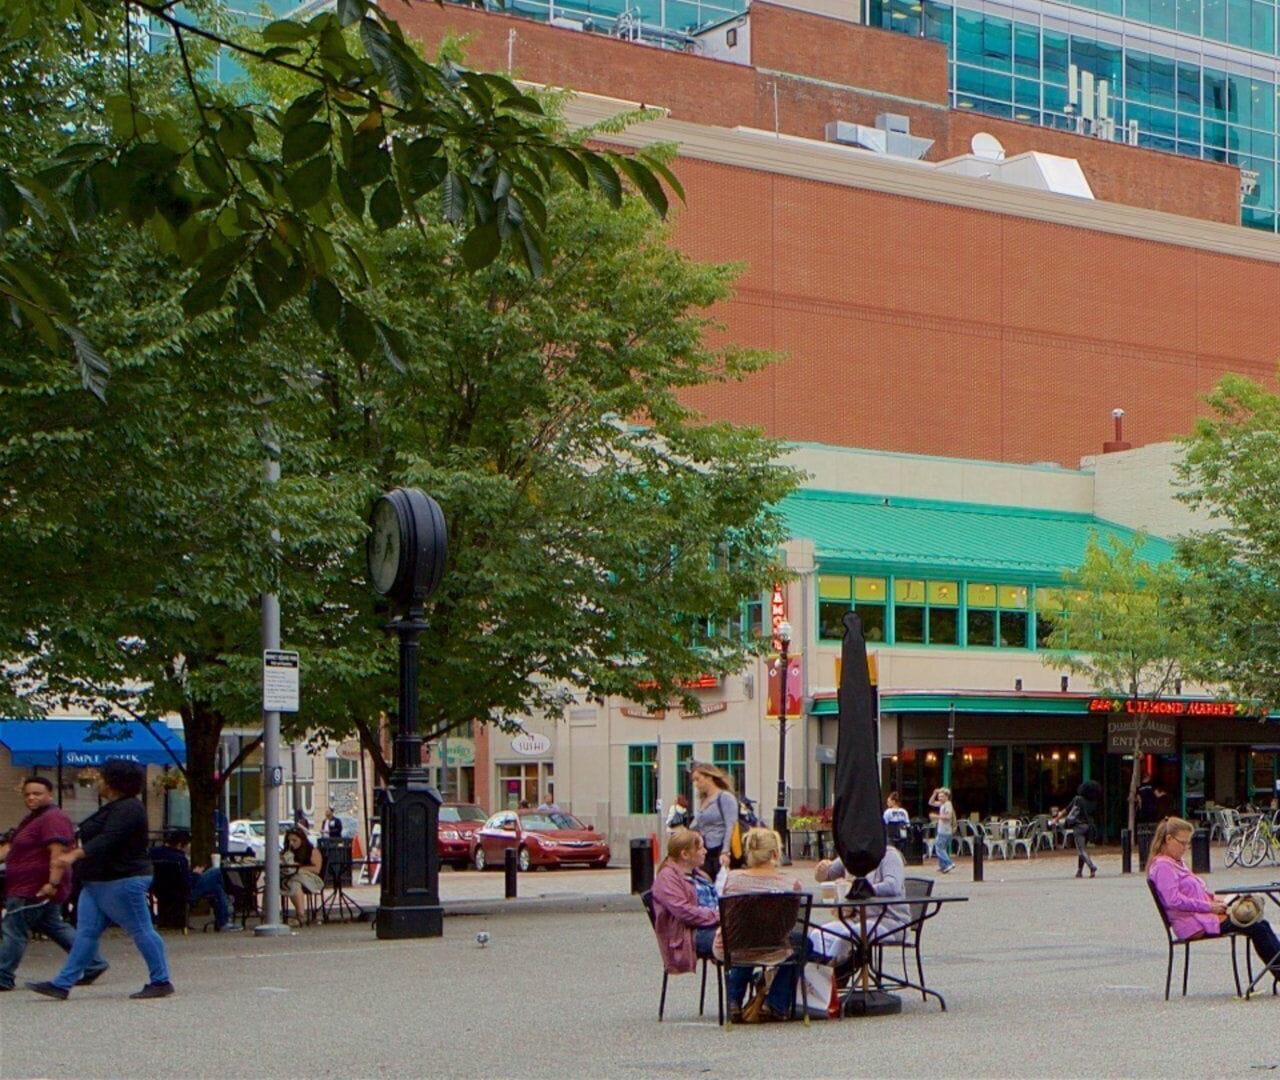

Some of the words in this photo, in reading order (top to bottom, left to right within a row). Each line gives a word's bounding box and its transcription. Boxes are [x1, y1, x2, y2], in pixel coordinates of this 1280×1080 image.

[1090, 700, 1112, 711] BAR
[1187, 702, 1236, 715] MARKET
[1112, 736, 1172, 748] ENTANCE
[66, 753, 100, 763] SIMPLE
